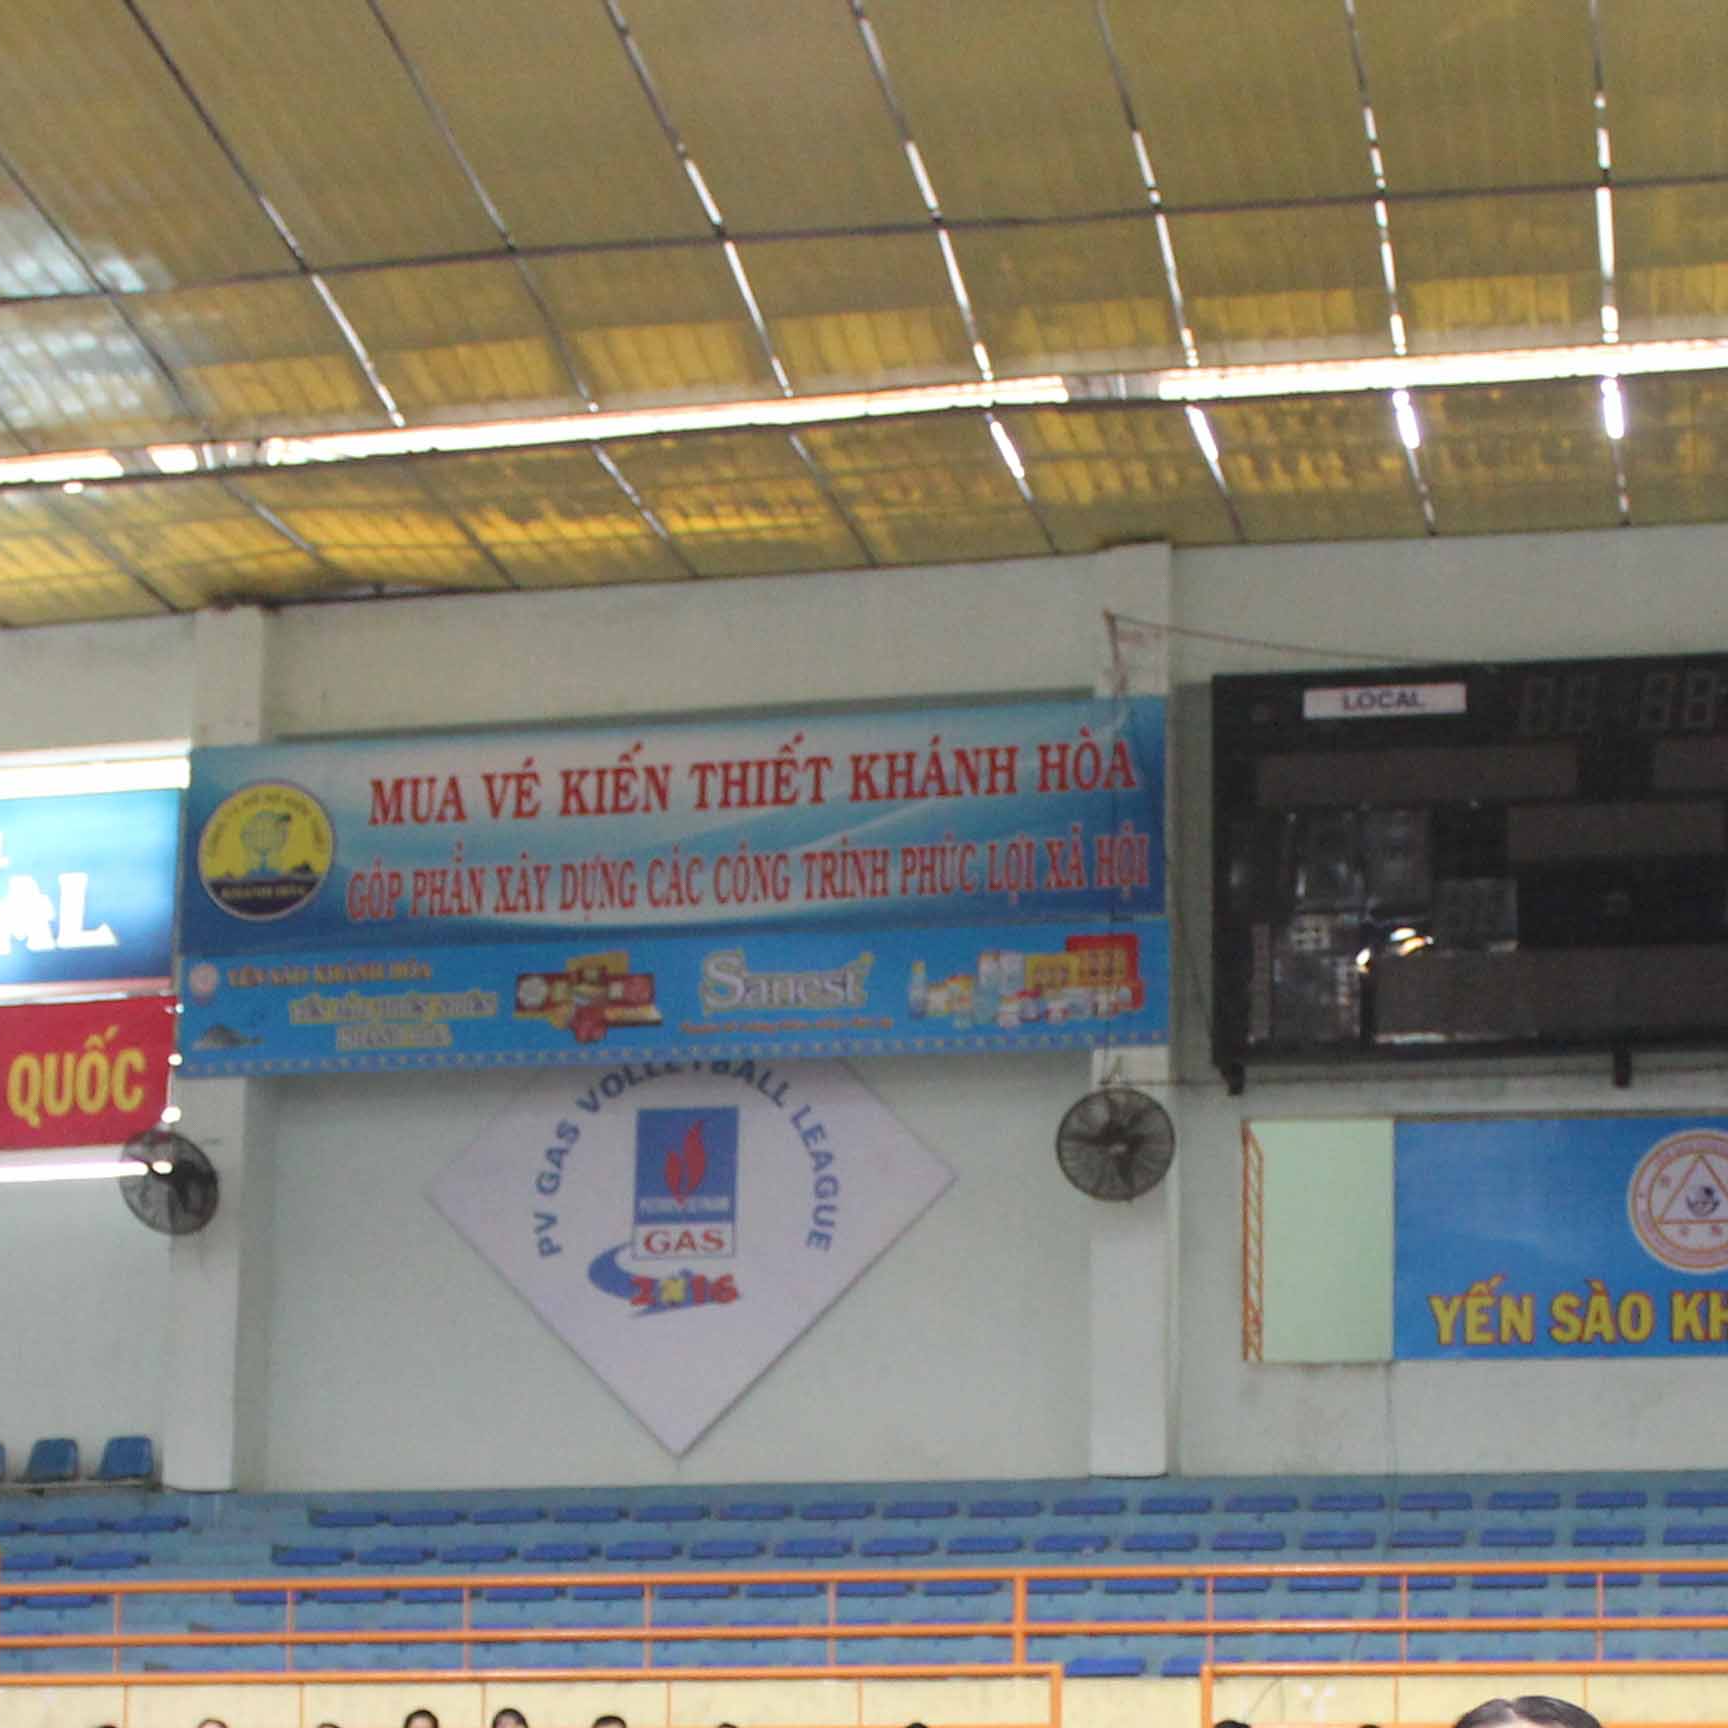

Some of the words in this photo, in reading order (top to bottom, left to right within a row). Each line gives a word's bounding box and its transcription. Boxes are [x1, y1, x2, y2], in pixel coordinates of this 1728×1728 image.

[1341, 690, 1424, 713] LOCAL
[368, 776, 466, 825] MUA
[482, 757, 542, 819] VÉ
[559, 742, 671, 816] KIẾN
[689, 731, 832, 811] THIẾT
[848, 735, 1020, 803] KHÁNH
[1037, 726, 1137, 793] HÒA
[346, 858, 404, 920] GÓP
[411, 842, 485, 917] PHẦN
[492, 852, 552, 914] XÂY
[559, 855, 638, 924] DỰNG
[646, 846, 705, 907] CÁC
[712, 841, 792, 905] CÔNG
[801, 838, 891, 900] TRÌNH
[899, 832, 978, 897] PHÚC
[1094, 818, 1150, 898] HỘI
[701, 950, 862, 1012] Sanest
[7, 1027, 148, 1119] QUỐC
[536, 1120, 580, 1196] GAS
[791, 1104, 839, 1251] LEAGUE
[533, 1211, 562, 1257] PV
[644, 1229, 725, 1254] GAS
[1428, 1276, 1534, 1346] YẾN
[1551, 1280, 1654, 1343] SÀO
